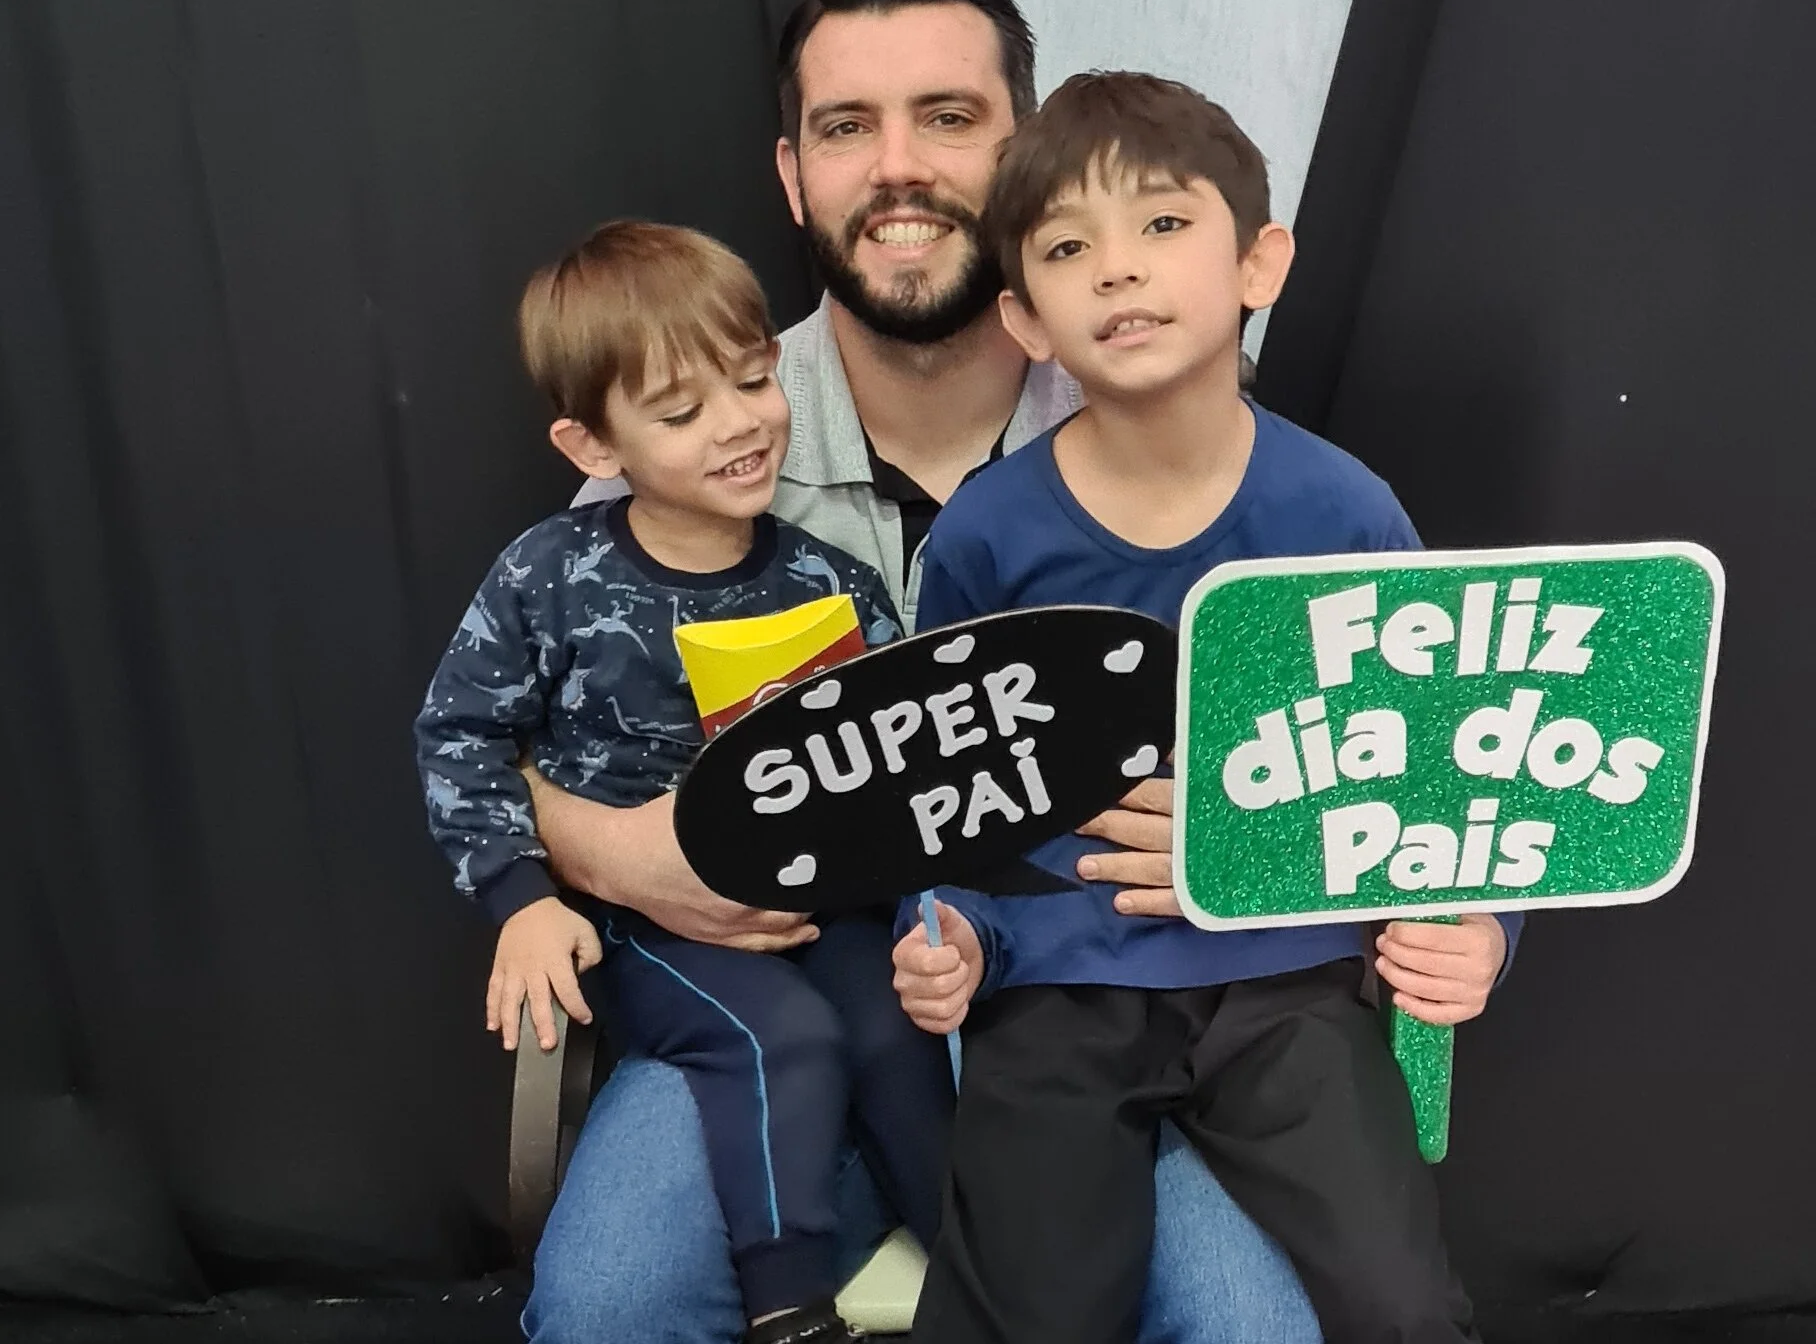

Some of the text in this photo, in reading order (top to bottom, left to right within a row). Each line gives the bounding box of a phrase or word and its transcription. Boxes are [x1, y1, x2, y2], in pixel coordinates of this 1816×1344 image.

[1308, 577, 1605, 689] Feliz
[744, 662, 1055, 814] SUPER
[1222, 688, 1665, 810] dia dos
[1320, 798, 1556, 897] Pais
